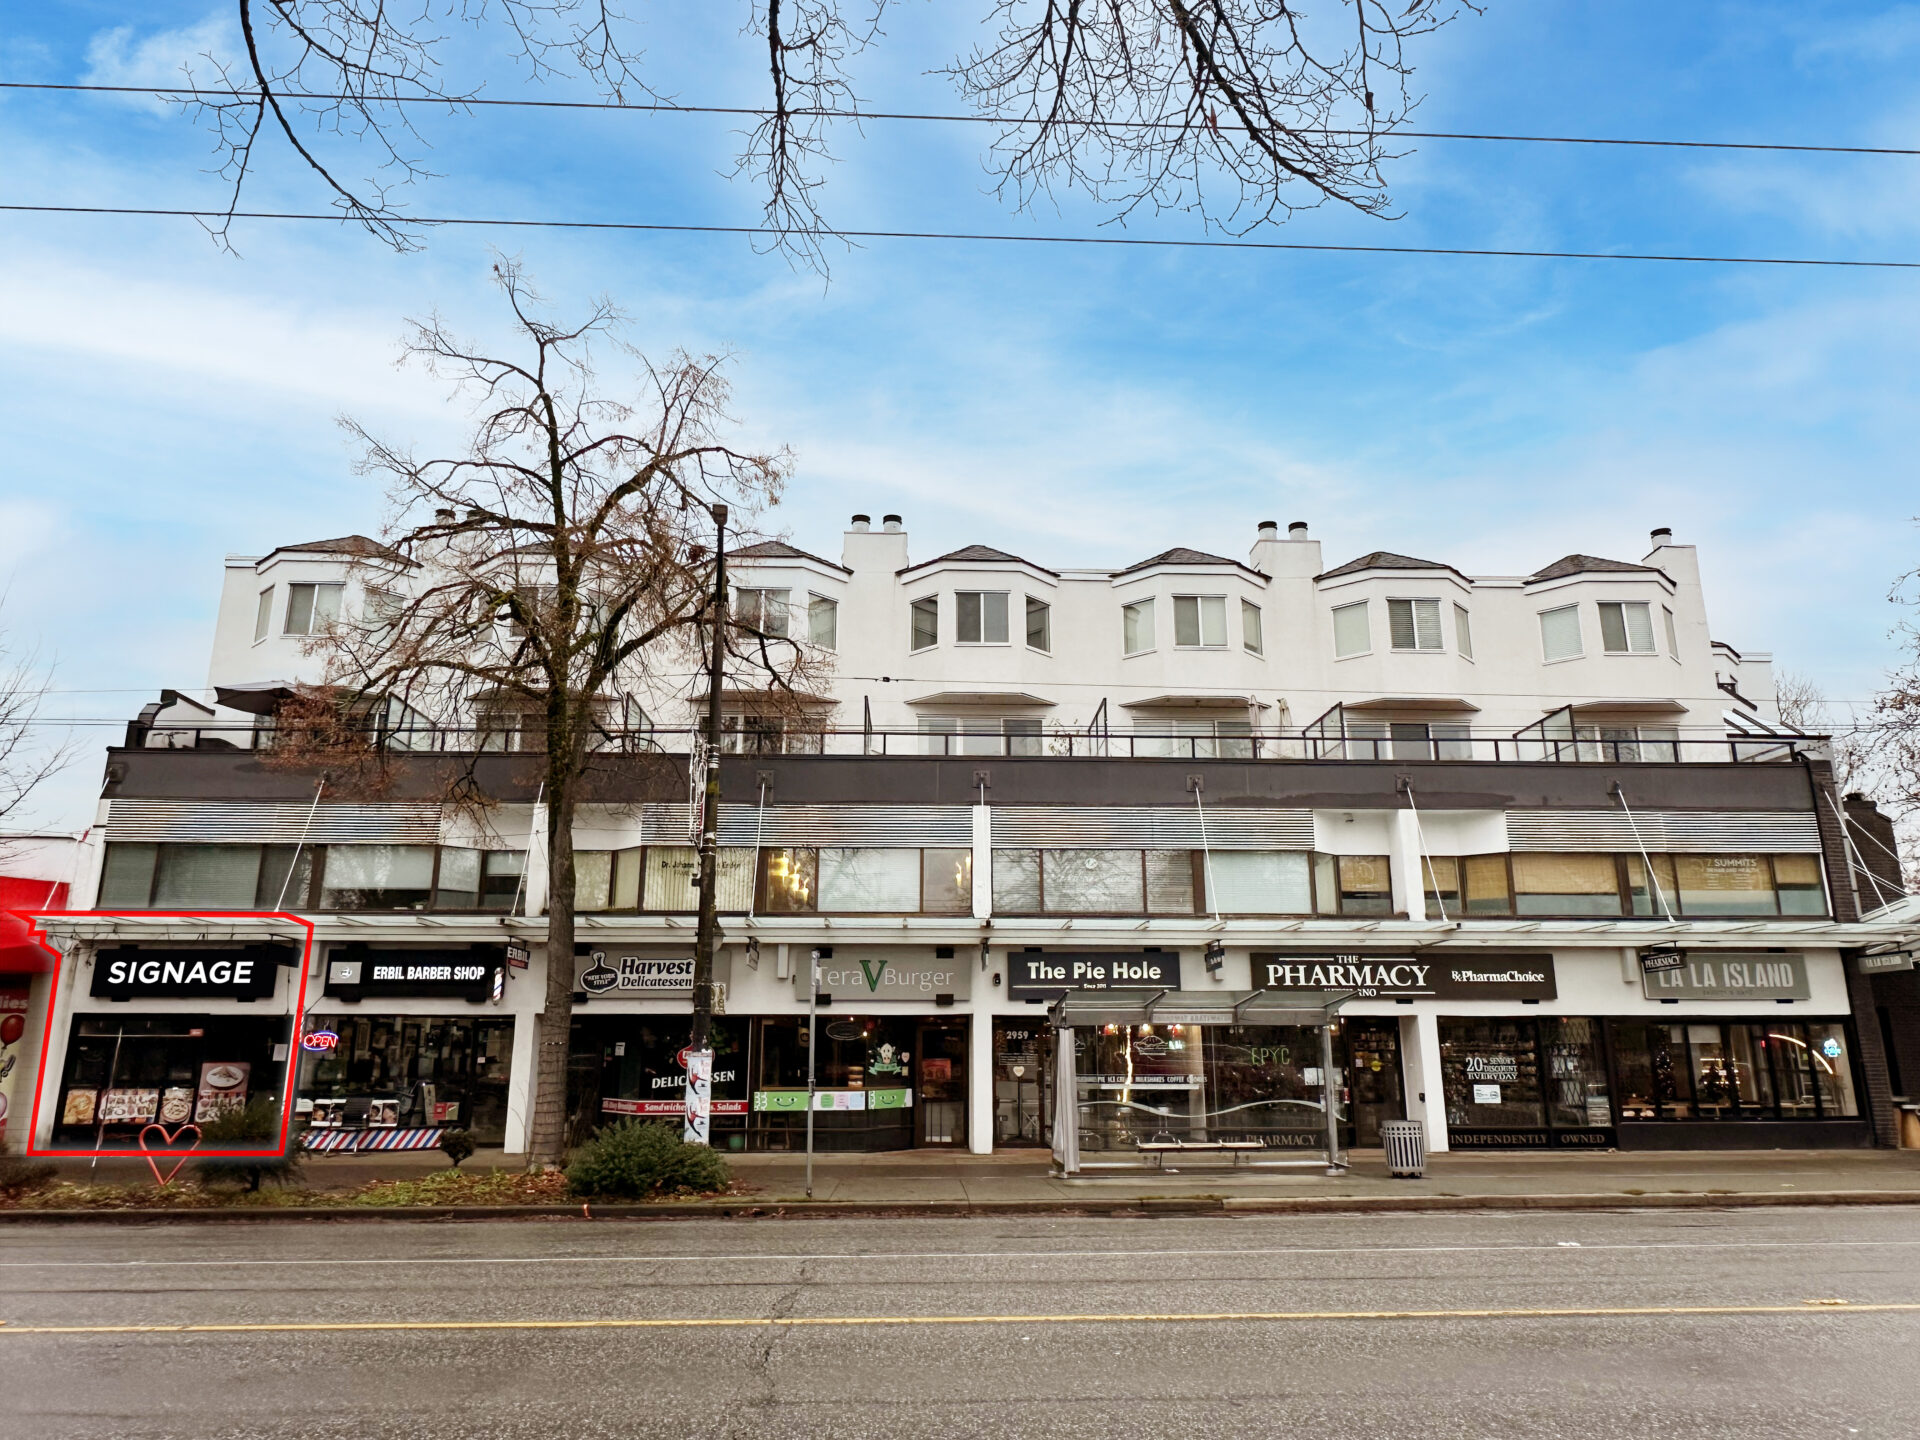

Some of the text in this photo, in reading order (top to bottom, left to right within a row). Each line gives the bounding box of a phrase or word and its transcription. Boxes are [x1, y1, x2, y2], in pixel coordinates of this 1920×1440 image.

[1714, 858, 1757, 867] SUMMITS
[507, 946, 529, 962] ERBIL
[1336, 955, 1360, 964] THE
[621, 958, 693, 975] Harvest
[1645, 954, 1681, 969] PHARMACY
[373, 966, 485, 980] ERBIL BARBER SHOP
[1027, 961, 1162, 980] The Pie Hole
[1266, 964, 1431, 987] PHARMACY
[1658, 963, 1794, 988] LA LA ISLAND
[621, 975, 692, 987] Delicatessen
[884, 968, 954, 991] Burger
[303, 1034, 338, 1048] OPEN
[1006, 1030, 1029, 1040] 2959
[716, 1103, 742, 1112] Salads
[1451, 1134, 1605, 1144] INDEPENDENTLY OWNED
